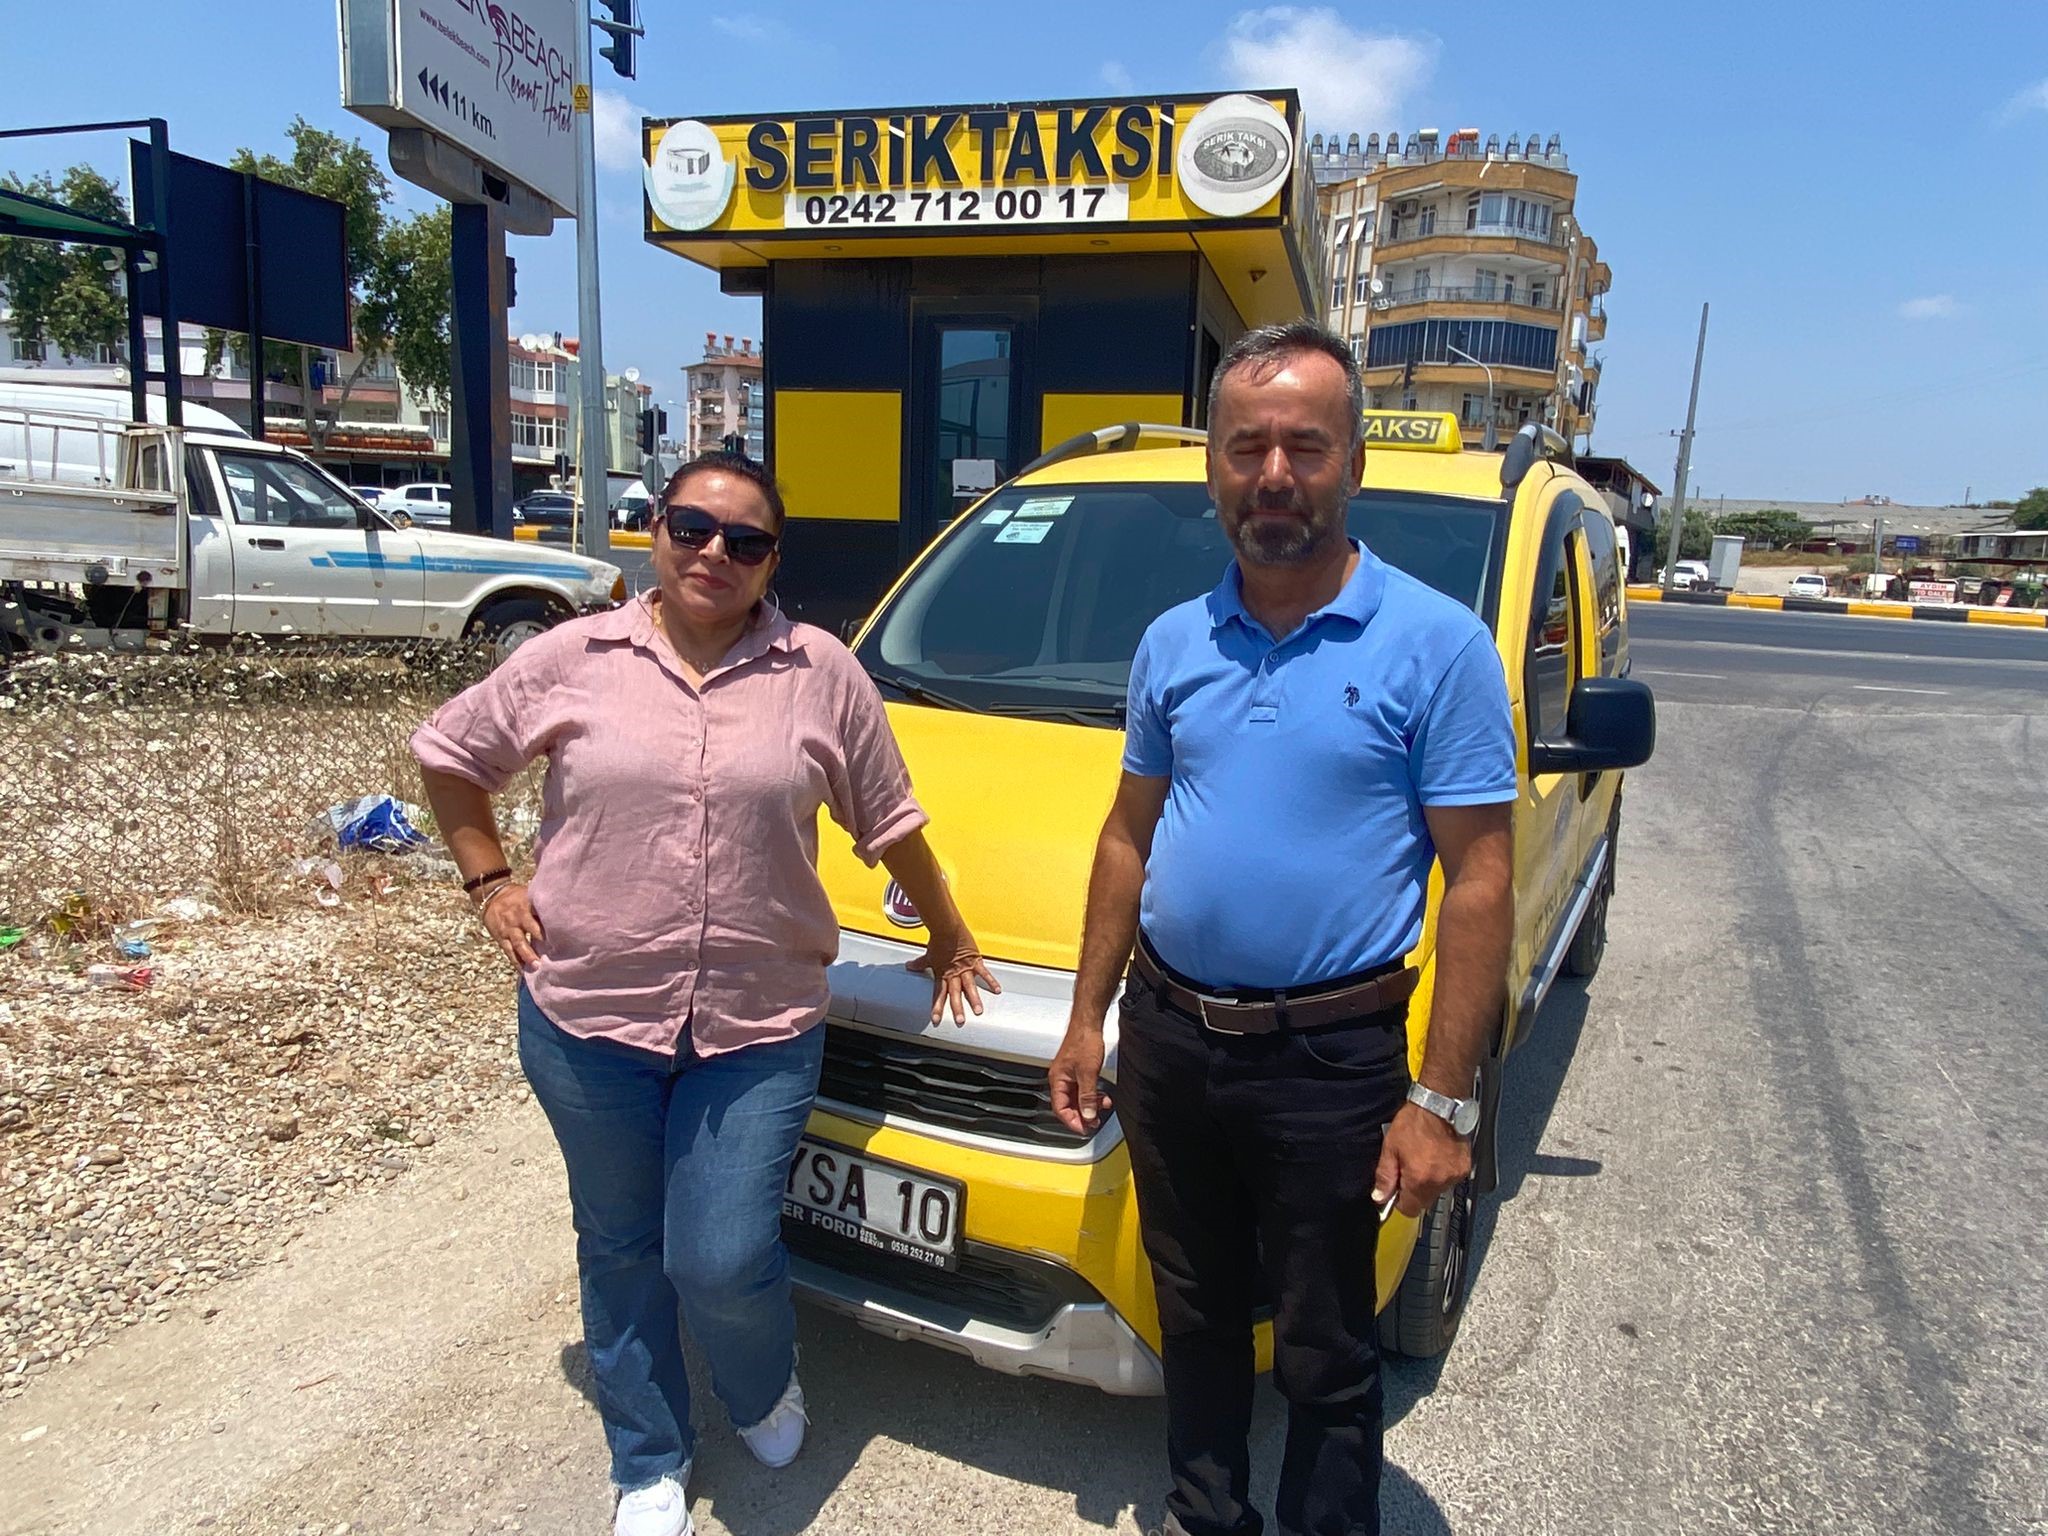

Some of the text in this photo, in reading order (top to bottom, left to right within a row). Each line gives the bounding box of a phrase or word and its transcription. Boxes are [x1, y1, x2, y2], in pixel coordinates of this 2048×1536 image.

[511, 12, 573, 96] BEACH
[452, 91, 497, 140] 11 km.
[492, 41, 573, 138] Resort Hotel
[745, 103, 1175, 192] SERİK TAKSİ
[805, 188, 1106, 225] 0242 712 00 17
[811, 1211, 858, 1239] FORD
[897, 1181, 950, 1245] 10
[910, 1246, 923, 1260] 252
[924, 1252, 934, 1264] 27
